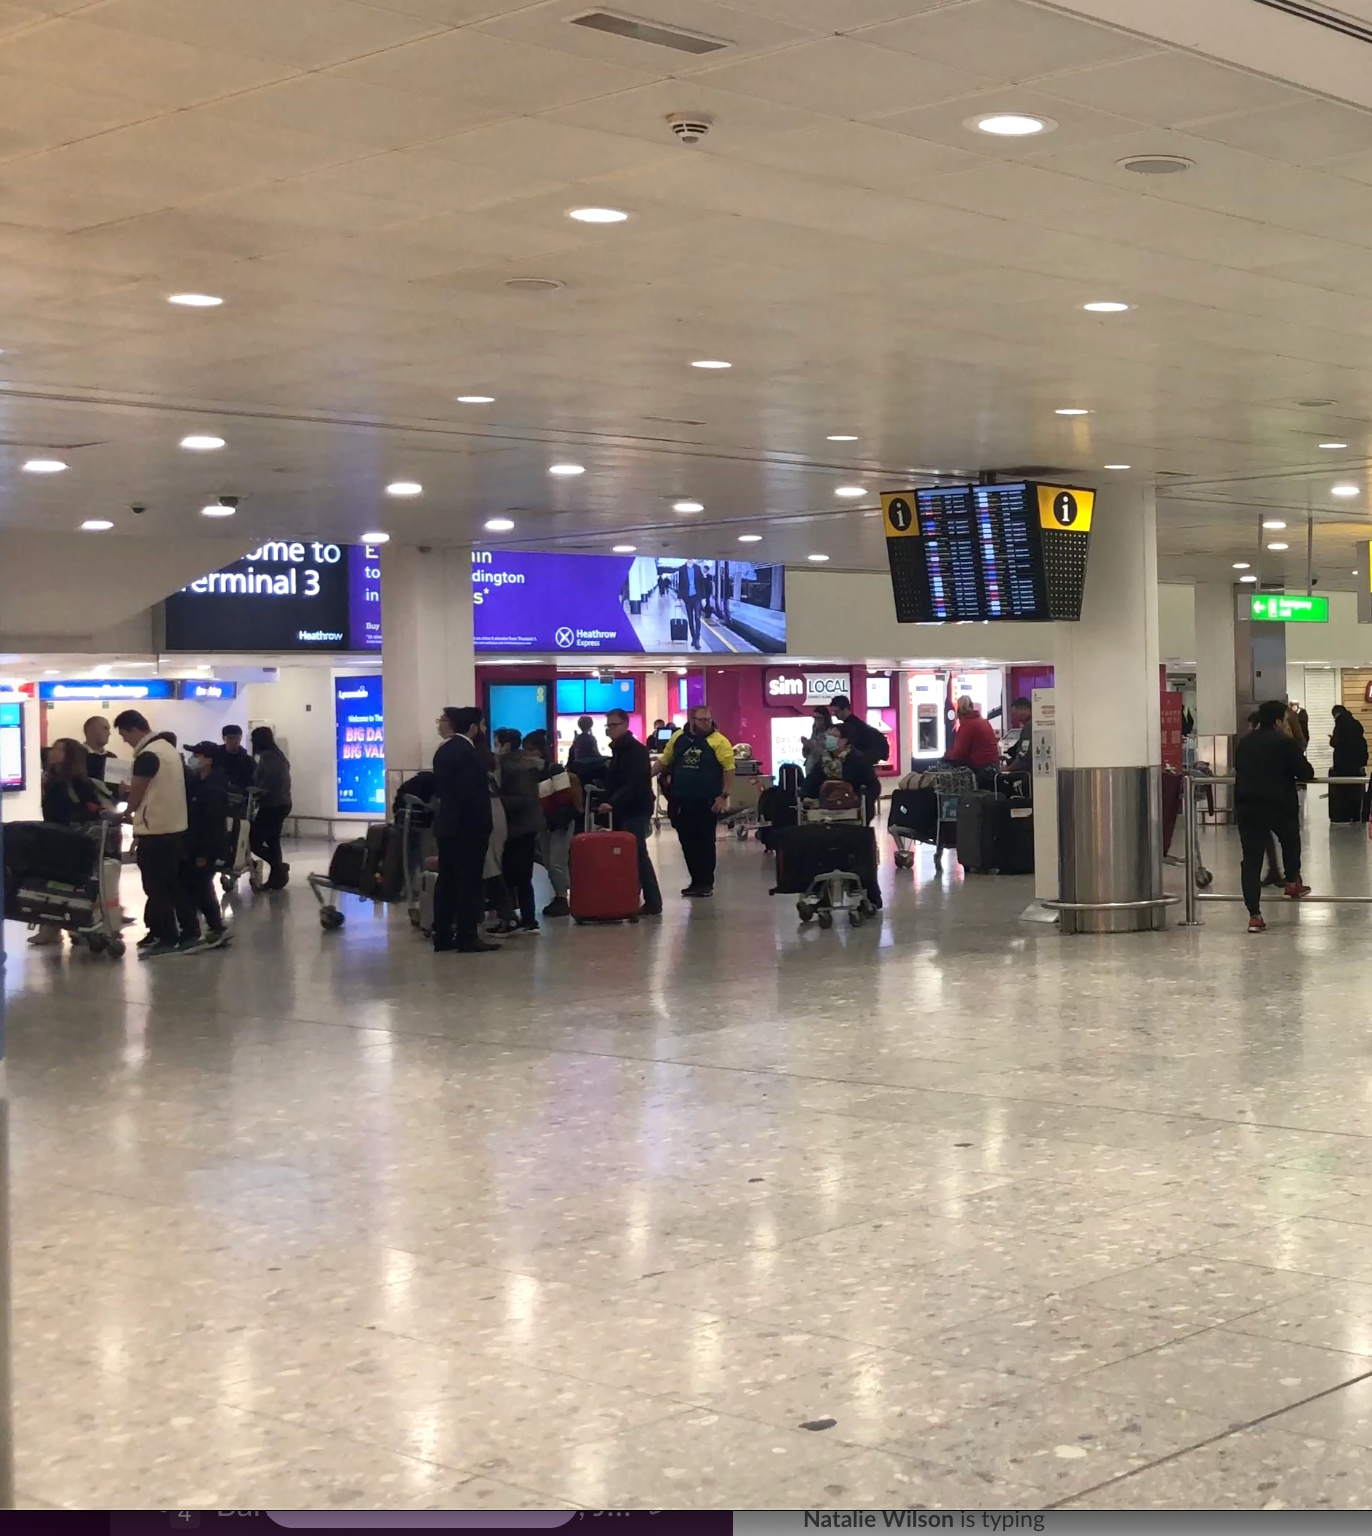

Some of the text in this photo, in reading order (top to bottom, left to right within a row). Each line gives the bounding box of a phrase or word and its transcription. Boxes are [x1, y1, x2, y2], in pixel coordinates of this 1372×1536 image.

[311, 541, 341, 563] to
[364, 566, 381, 579] to
[472, 570, 525, 586] dington
[303, 569, 320, 596] 3
[365, 588, 379, 601] in
[298, 630, 344, 641] Heathrow
[576, 629, 617, 639] Heathrow
[769, 675, 849, 695] sim LOCAL
[346, 727, 384, 742] BIG DA
[343, 744, 385, 759] BIG VAL
